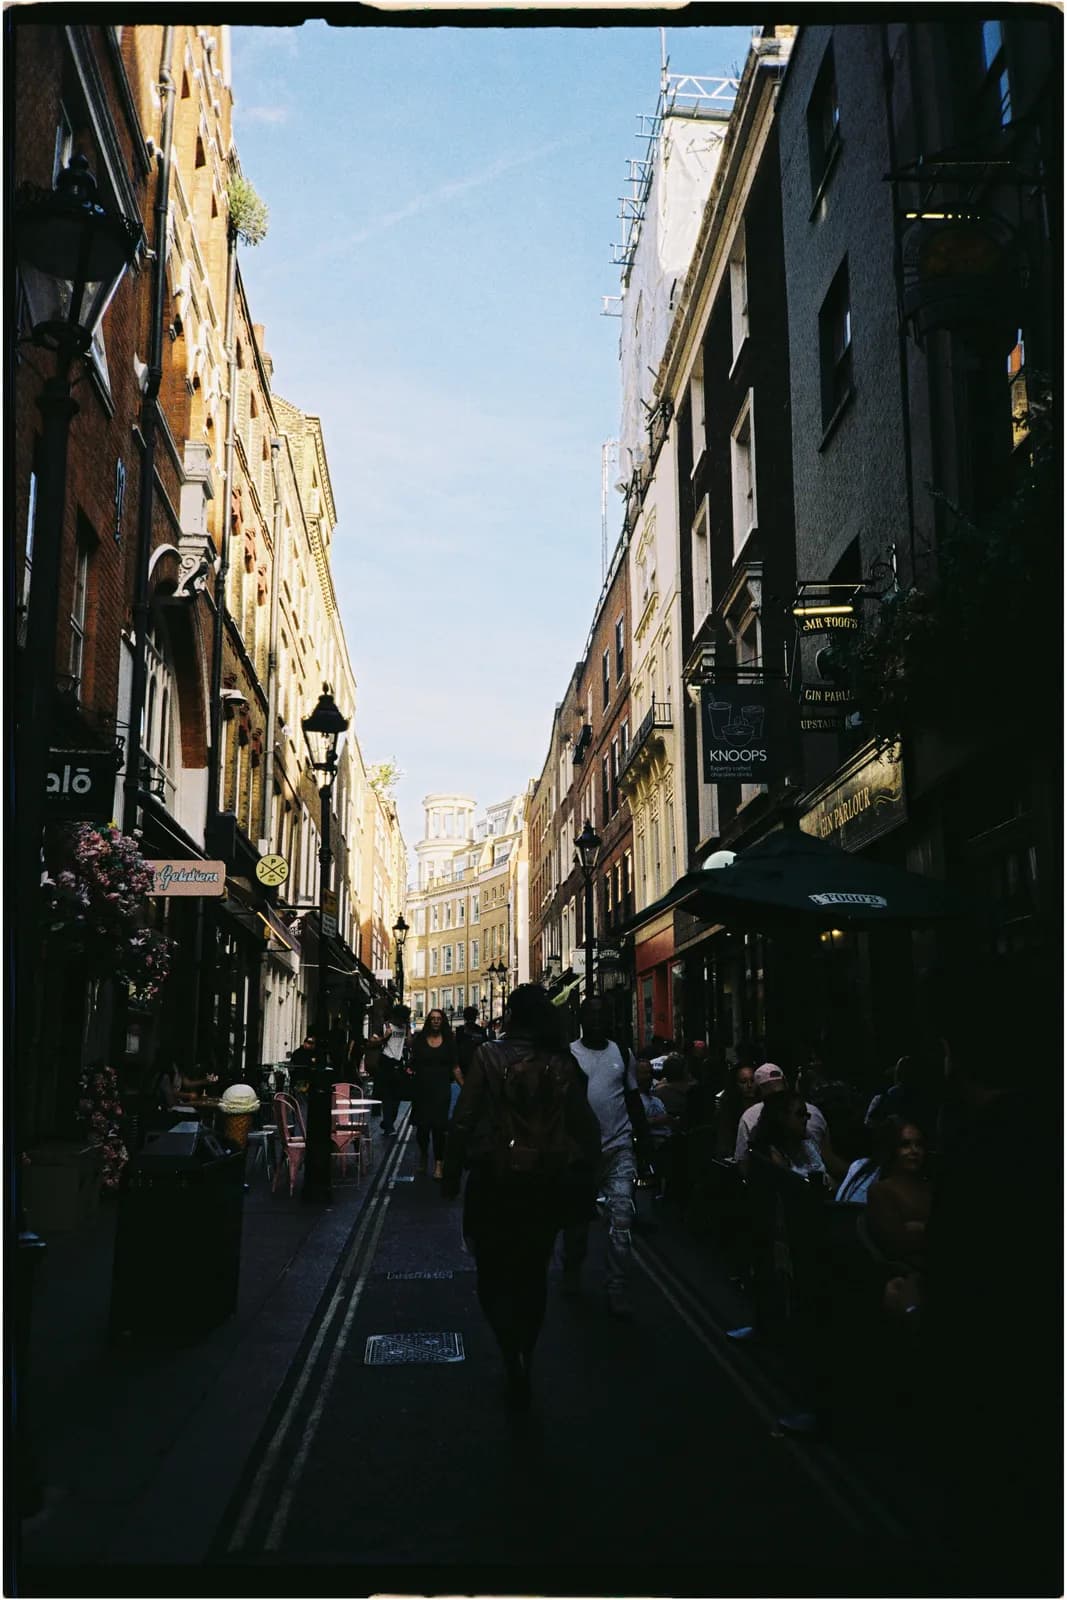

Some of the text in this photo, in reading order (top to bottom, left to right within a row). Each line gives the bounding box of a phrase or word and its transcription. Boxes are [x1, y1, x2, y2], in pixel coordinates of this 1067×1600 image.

[803, 617, 824, 631] MR
[805, 689, 822, 701] GIN
[710, 750, 768, 762] KNOOPS
[820, 787, 871, 839] GIN PARLOUR
